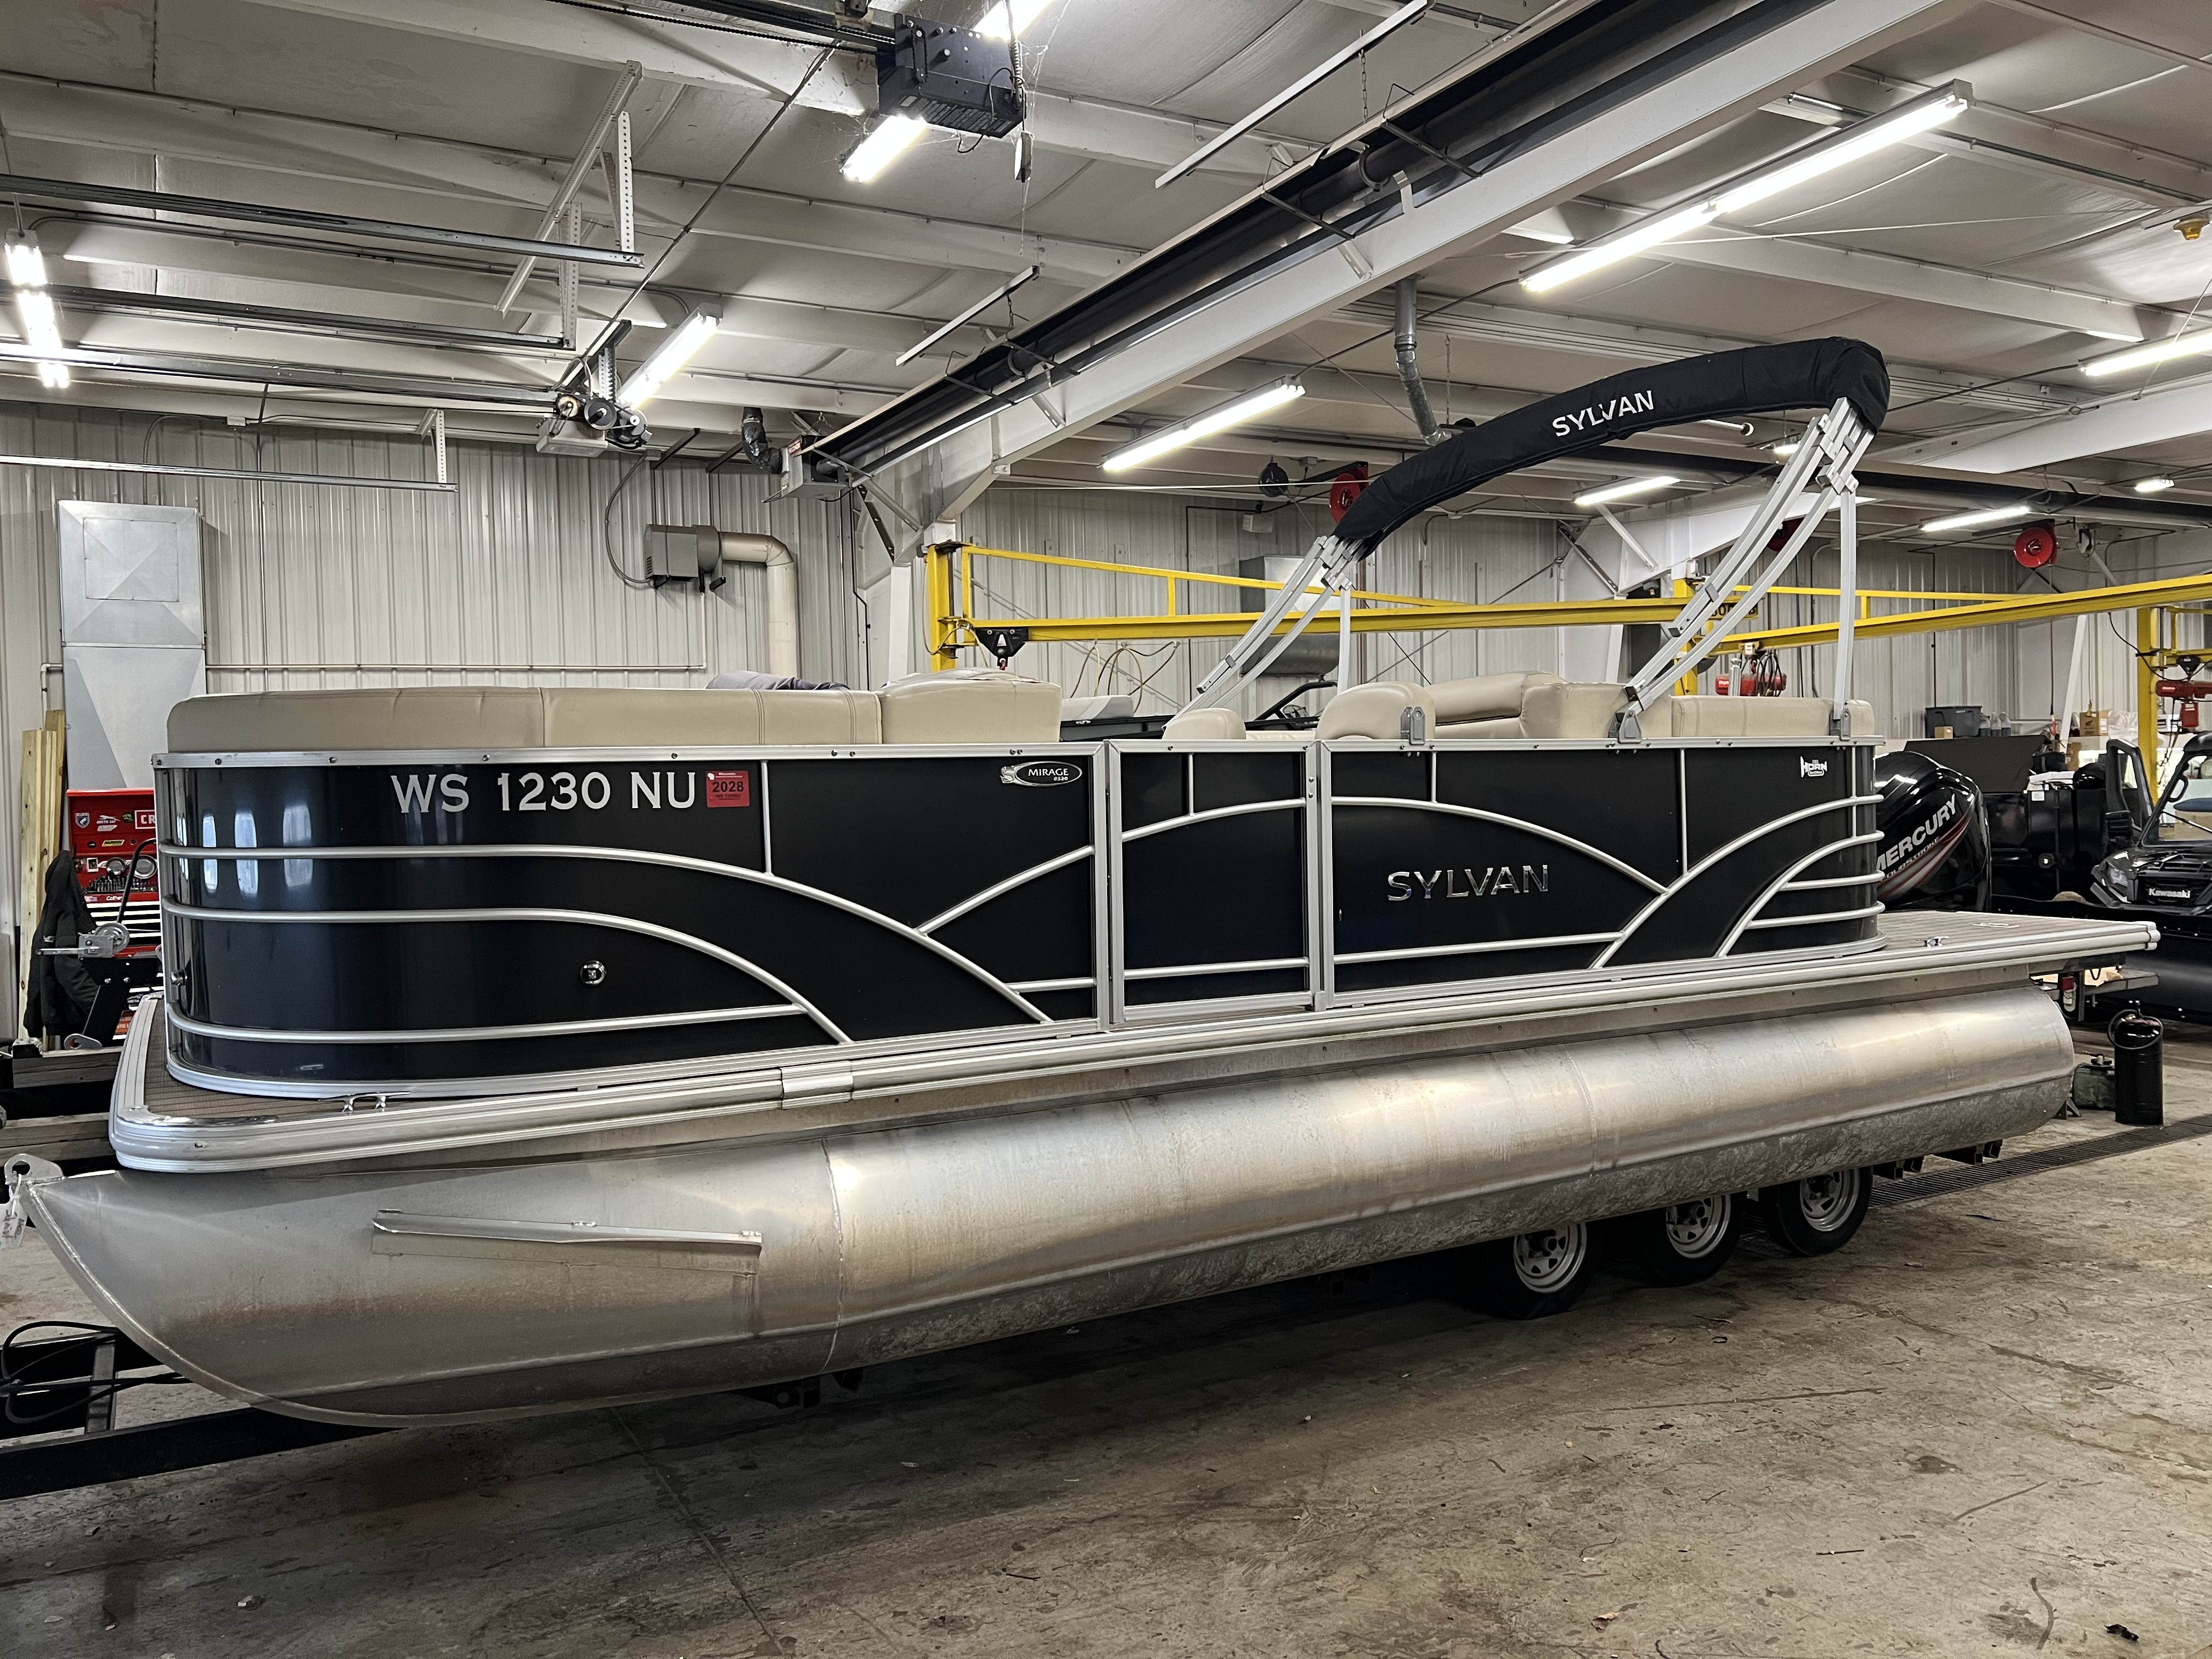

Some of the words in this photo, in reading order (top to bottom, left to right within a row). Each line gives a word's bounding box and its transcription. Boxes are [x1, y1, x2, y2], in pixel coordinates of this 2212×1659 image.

[1552, 390, 1654, 437] SYLVAN
[1028, 768, 1069, 776] MIRAGE
[390, 774, 470, 813] WS
[498, 771, 611, 811] 1230
[631, 772, 695, 809] NU
[713, 781, 744, 792] 2028
[1387, 865, 1548, 901] SYLVAN
[2148, 888, 2191, 898] Kawasaki
